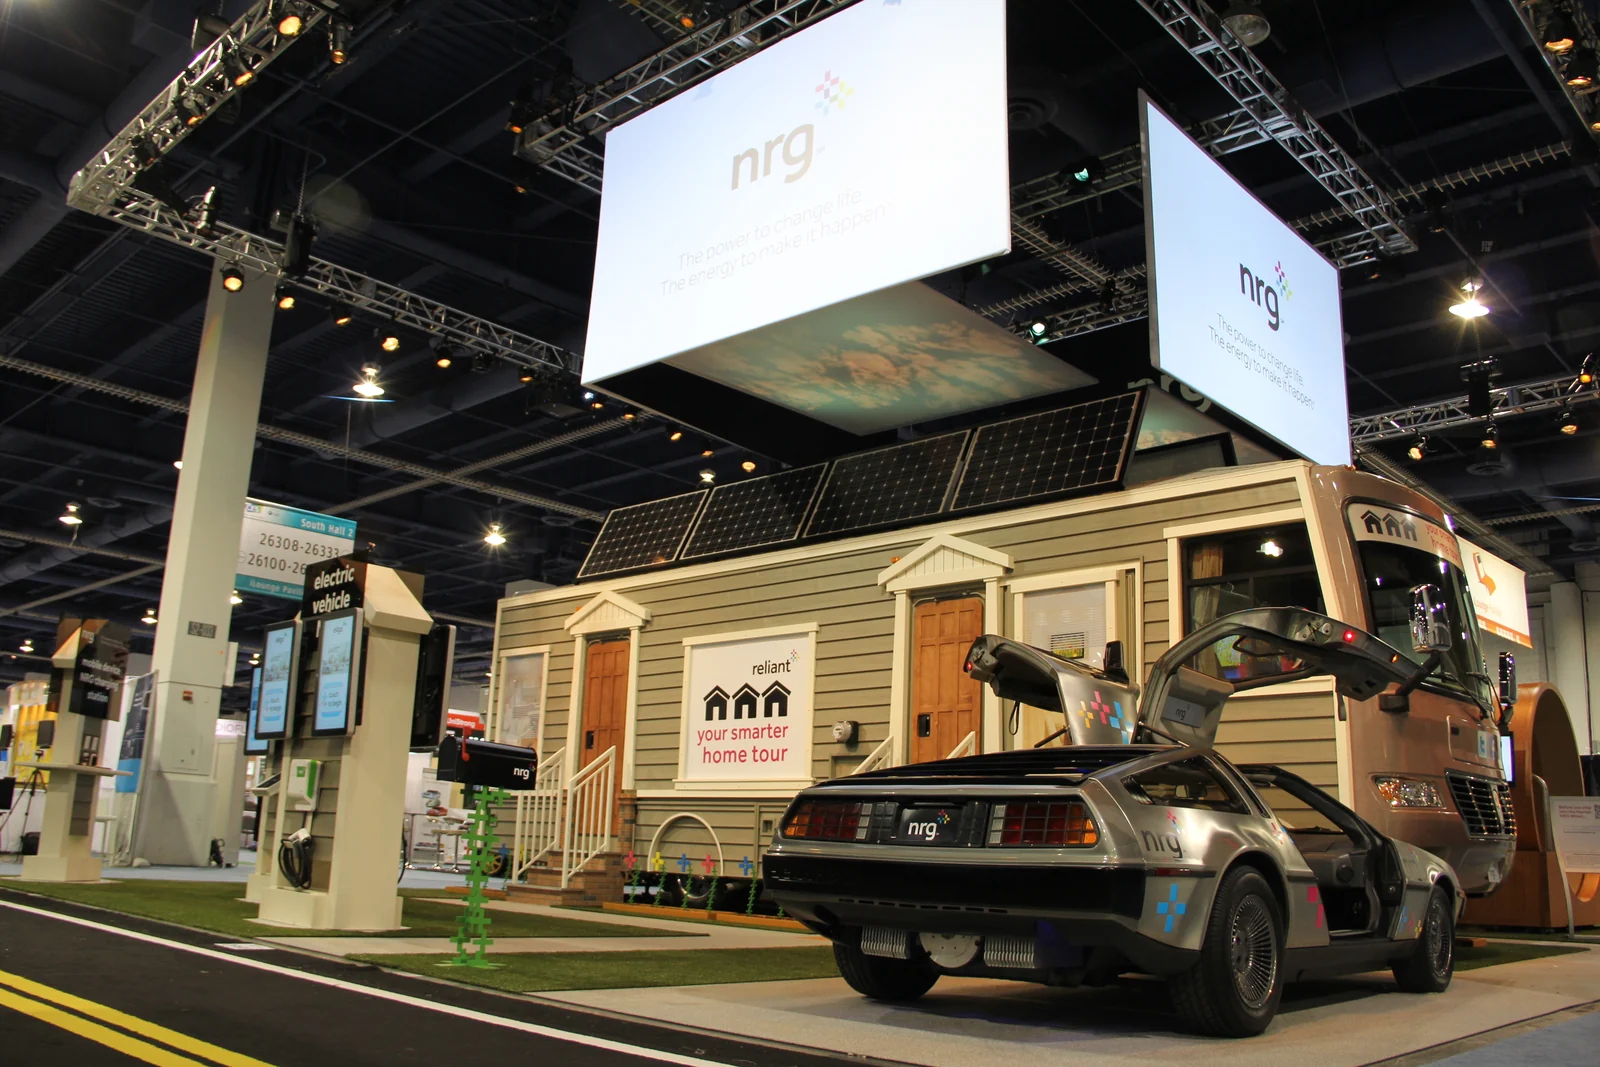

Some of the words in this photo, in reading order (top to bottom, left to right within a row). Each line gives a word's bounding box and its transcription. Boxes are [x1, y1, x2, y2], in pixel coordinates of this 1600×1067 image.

[731, 124, 814, 190] nrg
[678, 249, 703, 270] The
[706, 231, 751, 260] power
[753, 224, 770, 241] to
[773, 200, 833, 234] change
[660, 278, 685, 298] The
[688, 259, 737, 286] energy
[741, 251, 756, 268] to
[760, 234, 802, 261] make
[805, 228, 817, 243] it
[820, 203, 885, 239] happen
[1239, 263, 1280, 331] nrg
[1208, 325, 1225, 349] The
[1226, 341, 1252, 371] energy
[1253, 359, 1261, 374] to
[1263, 366, 1282, 388] make
[1217, 313, 1233, 336] The
[1234, 329, 1257, 351] power
[1258, 345, 1266, 359] to
[1267, 352, 1292, 379] change
[301, 518, 325, 531] South
[328, 523, 345, 536] Hall
[348, 528, 354, 537] 2
[259, 533, 340, 559] 26308-26333
[313, 564, 355, 590] electric
[312, 590, 351, 614] vehicle
[81, 658, 102, 671] mobile
[102, 662, 121, 675] device
[752, 659, 791, 675] reliant
[86, 691, 109, 703] station
[1175, 707, 1186, 720] nrg
[697, 728, 728, 746] your
[731, 723, 788, 741] smarter
[703, 746, 747, 763] home
[752, 745, 788, 763] tour
[513, 767, 530, 780] nrg
[907, 822, 938, 841] nrg
[1141, 830, 1184, 859] nrg
